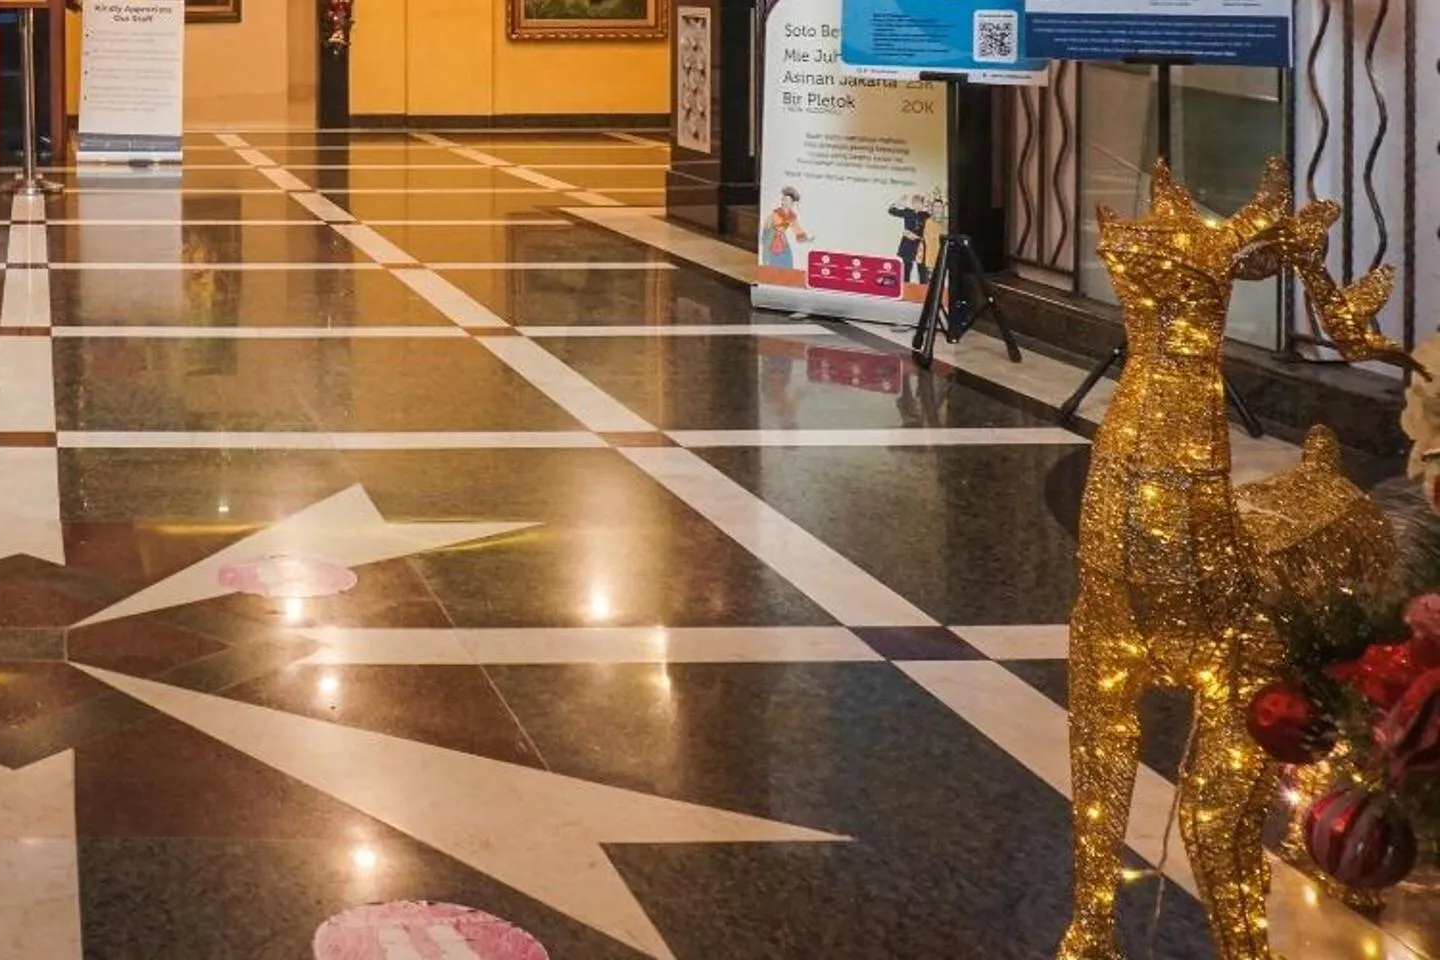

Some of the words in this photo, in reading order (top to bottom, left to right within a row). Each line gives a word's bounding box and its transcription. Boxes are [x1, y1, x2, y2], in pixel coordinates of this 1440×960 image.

[785, 23, 817, 38] Soto
[783, 48, 810, 63] Mie
[782, 70, 835, 86] Asinan
[782, 91, 803, 105] Bir
[807, 93, 856, 109] Pletok
[901, 98, 935, 115] 20K
